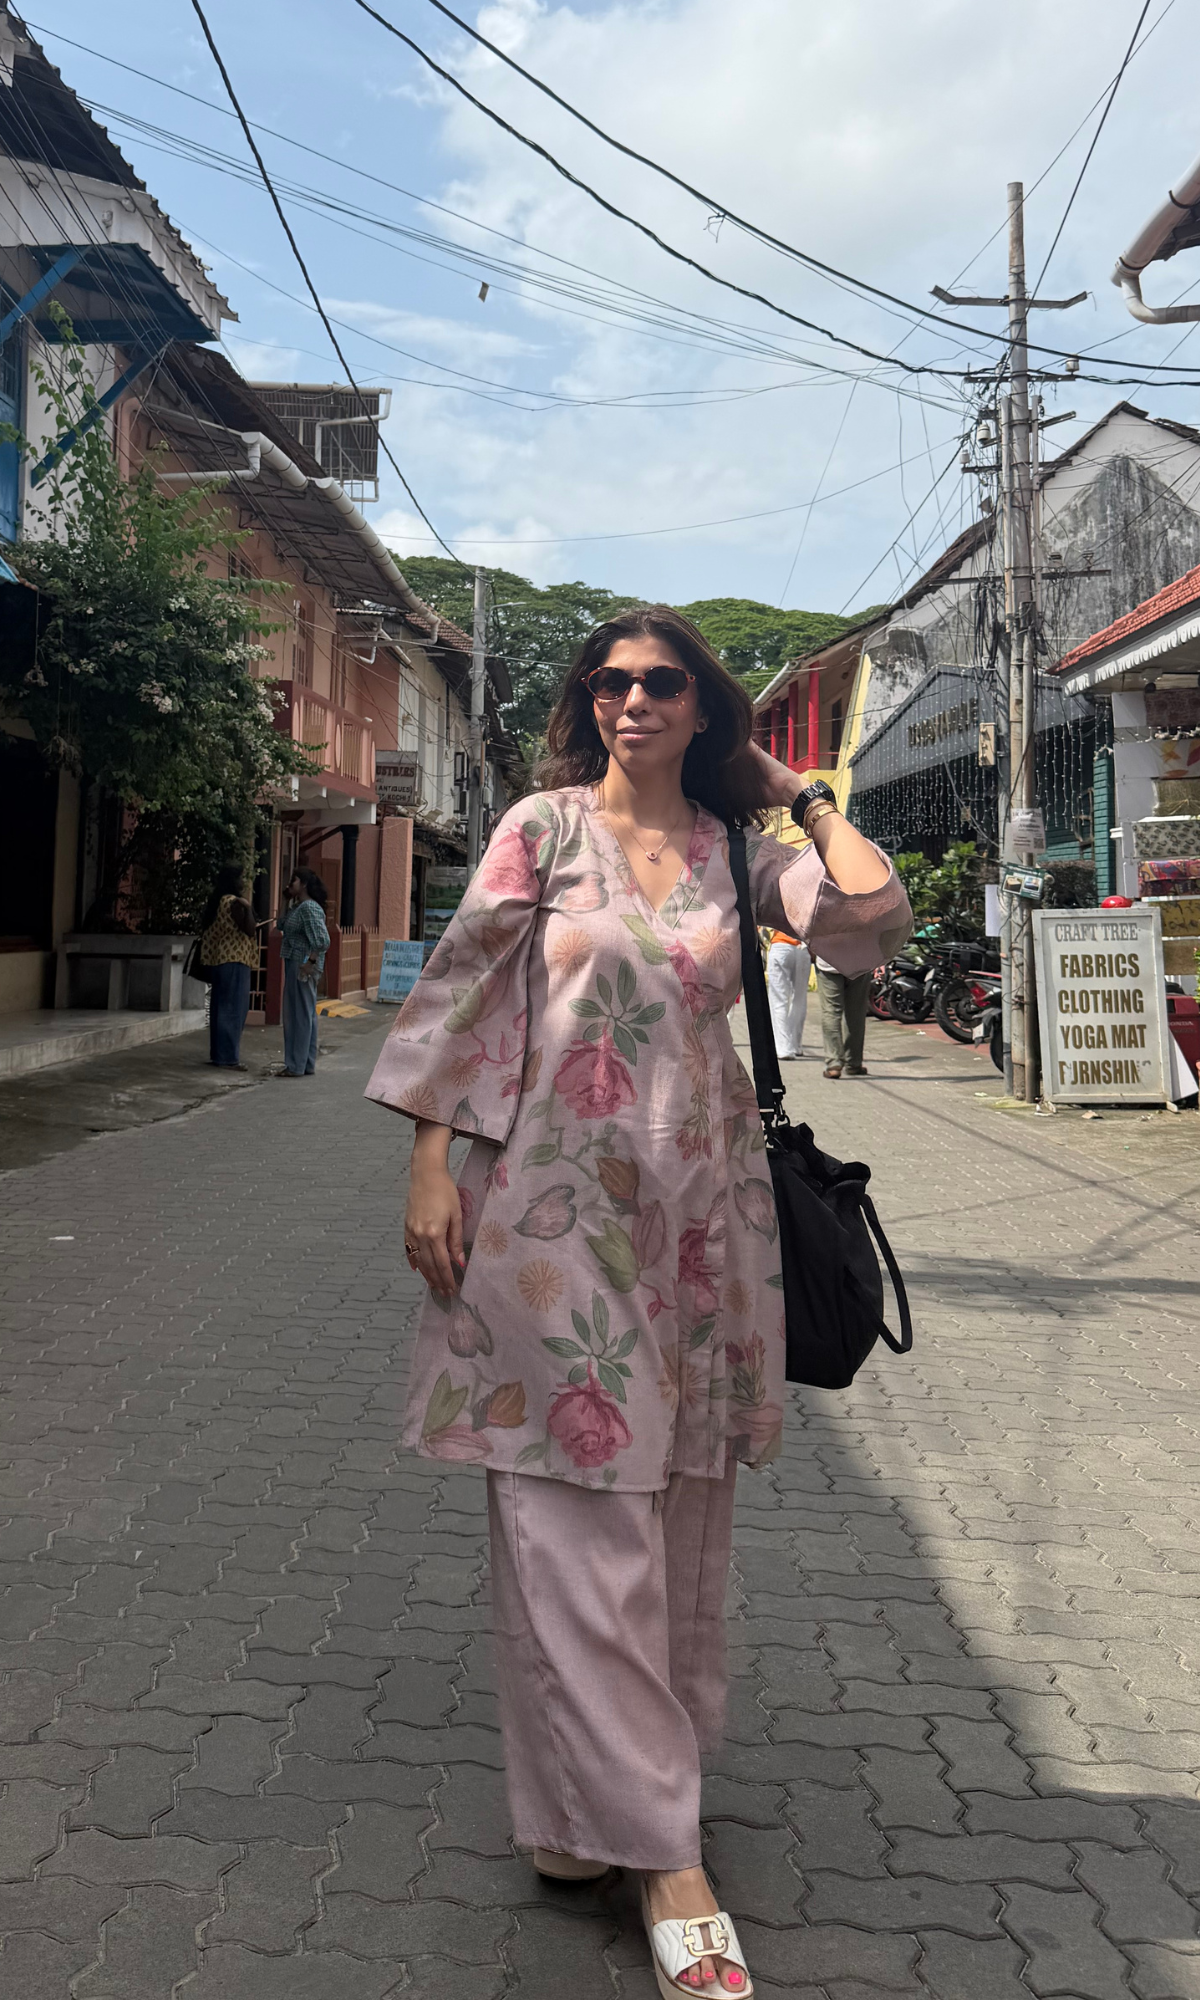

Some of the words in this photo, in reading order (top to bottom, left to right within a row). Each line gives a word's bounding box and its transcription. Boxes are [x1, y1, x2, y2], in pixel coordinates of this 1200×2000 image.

[1055, 923, 1098, 942] CRAFT
[1101, 922, 1138, 941] TREE
[1060, 953, 1140, 978] FABRICS
[1058, 989, 1144, 1014] CLOTHING
[1059, 1024, 1108, 1050] YOGA
[1111, 1024, 1147, 1049] MAT
